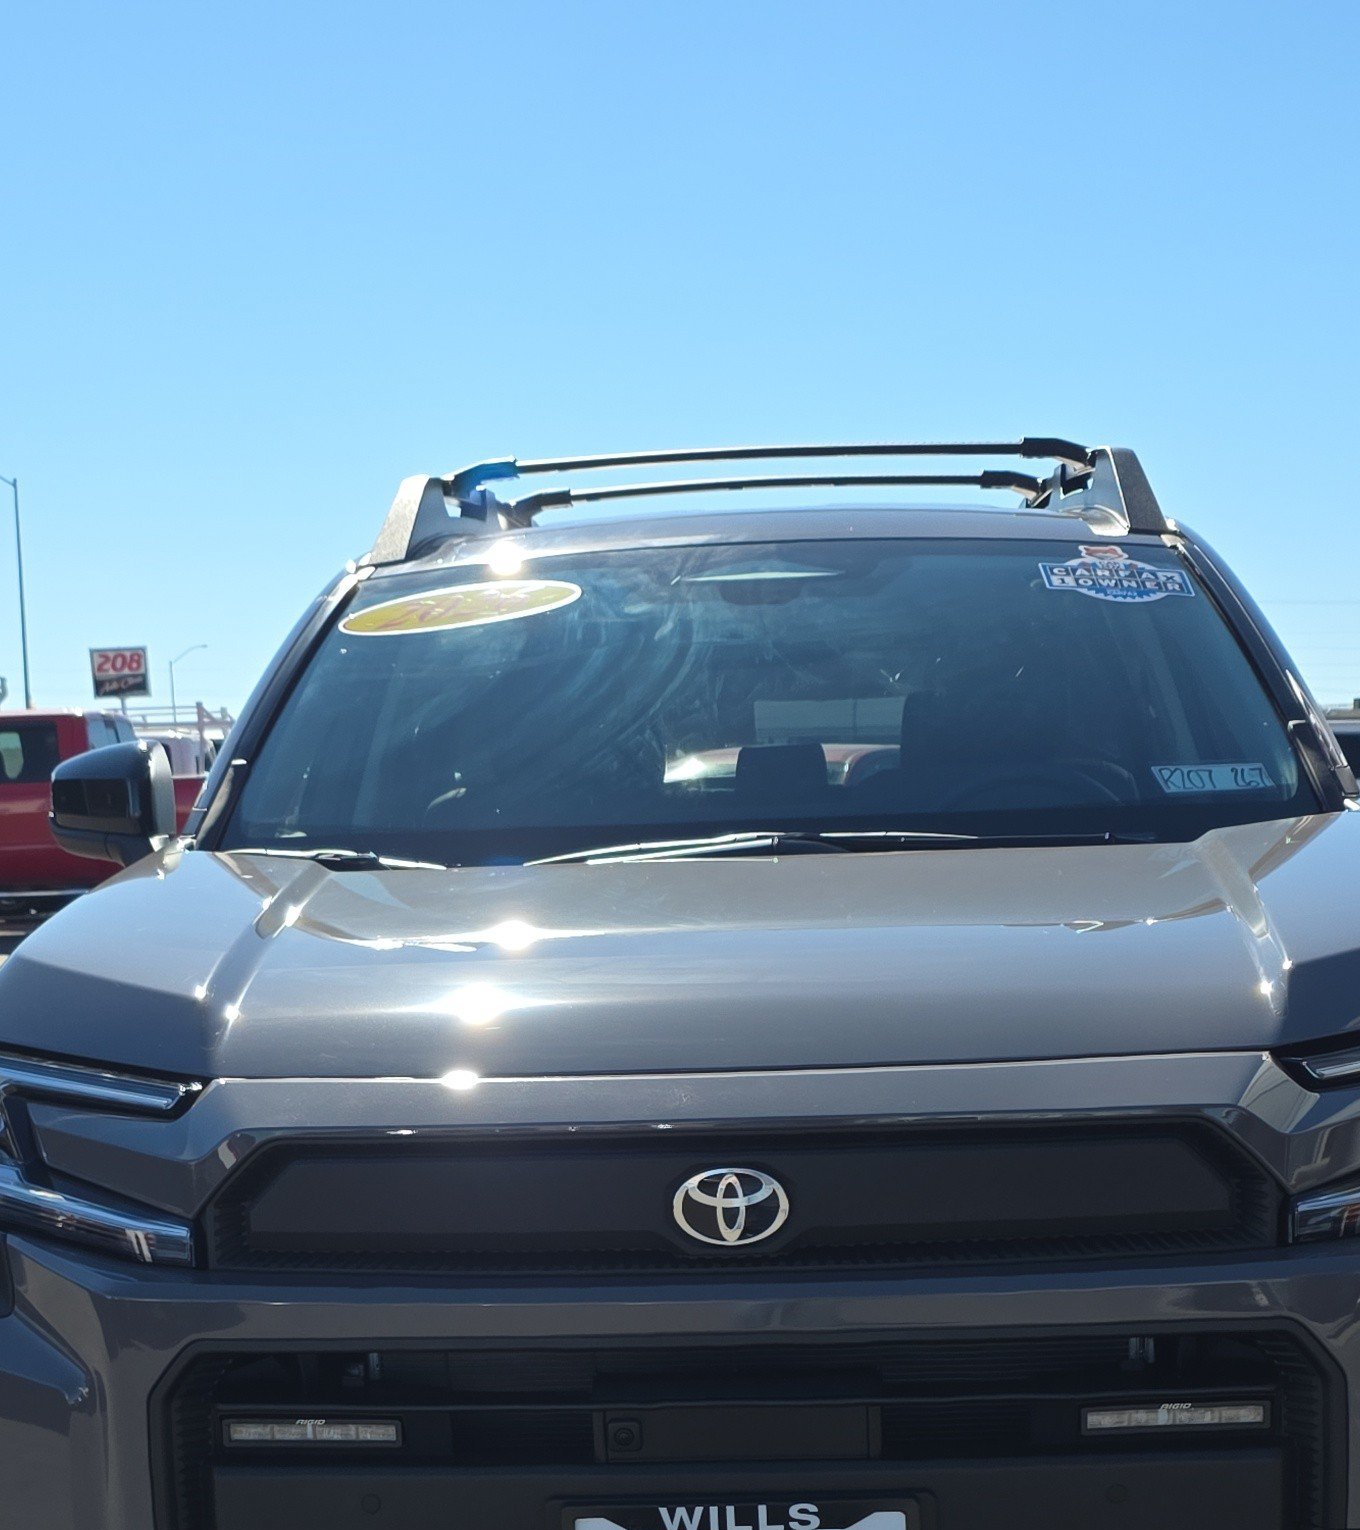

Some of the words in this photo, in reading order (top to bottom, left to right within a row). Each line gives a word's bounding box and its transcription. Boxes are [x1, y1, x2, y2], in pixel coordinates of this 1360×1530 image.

[1052, 567, 1176, 582] CARFAX
[1078, 578, 1180, 591] OWNER
[97, 652, 143, 673] 208
